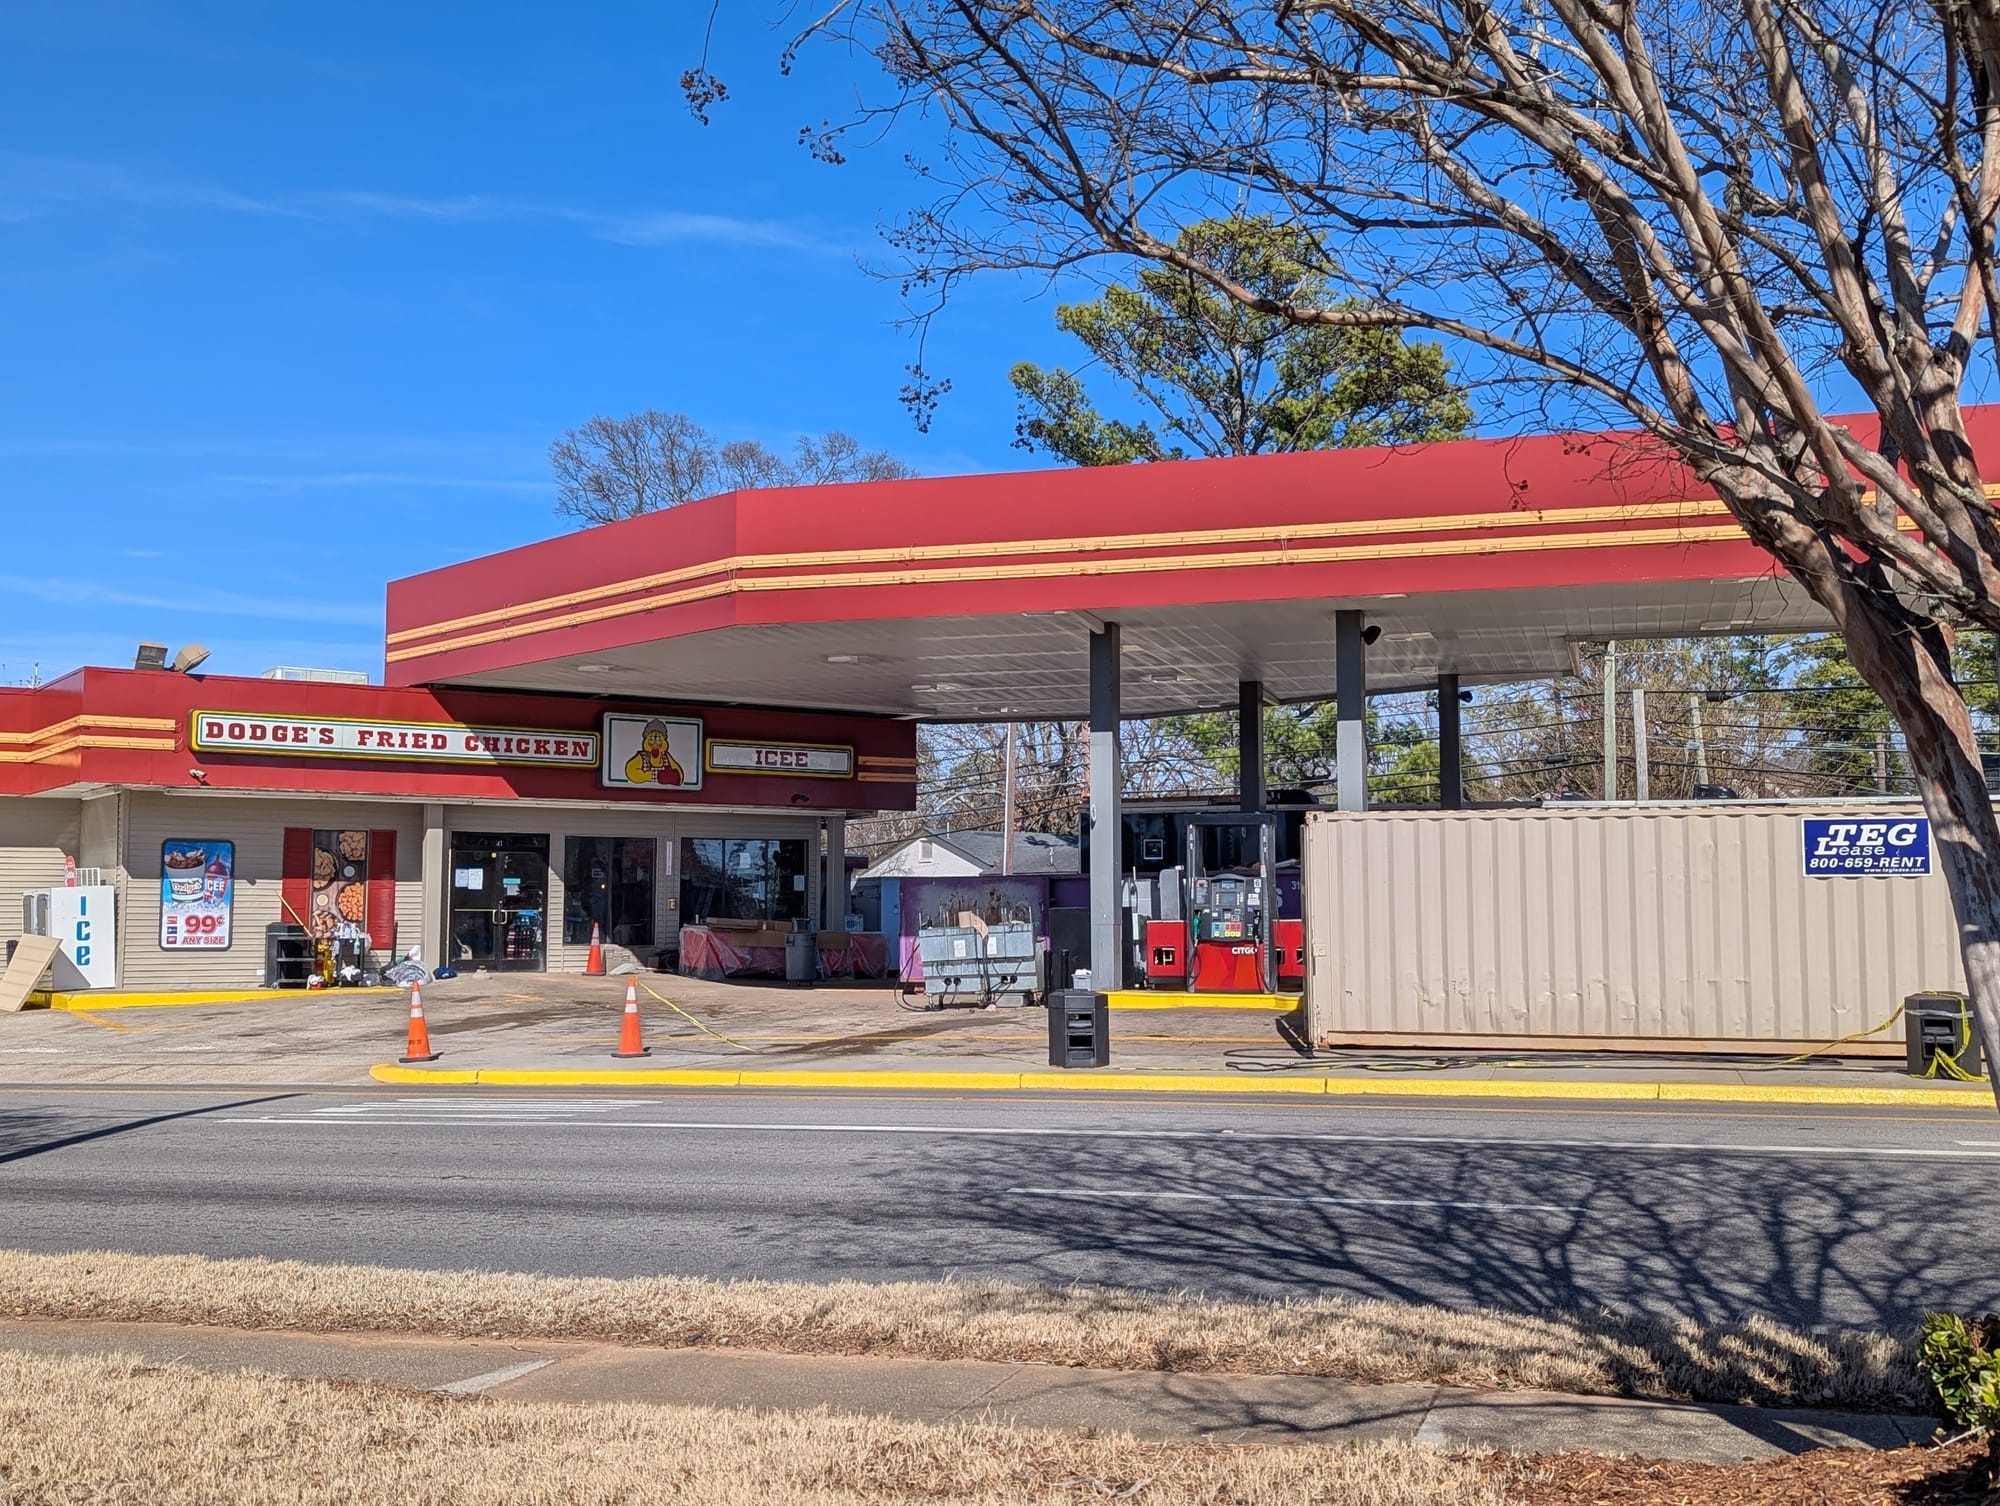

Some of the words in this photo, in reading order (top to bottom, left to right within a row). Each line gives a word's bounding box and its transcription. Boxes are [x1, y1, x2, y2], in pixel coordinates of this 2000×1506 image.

[206, 722, 334, 745] DODGE'S
[357, 730, 448, 750] FRIED
[464, 735, 590, 757] CHICKEN
[755, 750, 808, 768] ICEE
[1828, 823, 1918, 846] TEG
[1814, 837, 1886, 856] Lease
[1809, 856, 1926, 869] 800-659-RENT
[181, 935, 203, 945] ANY
[203, 935, 226, 945] SIZE
[1231, 946, 1258, 955] CITGO
